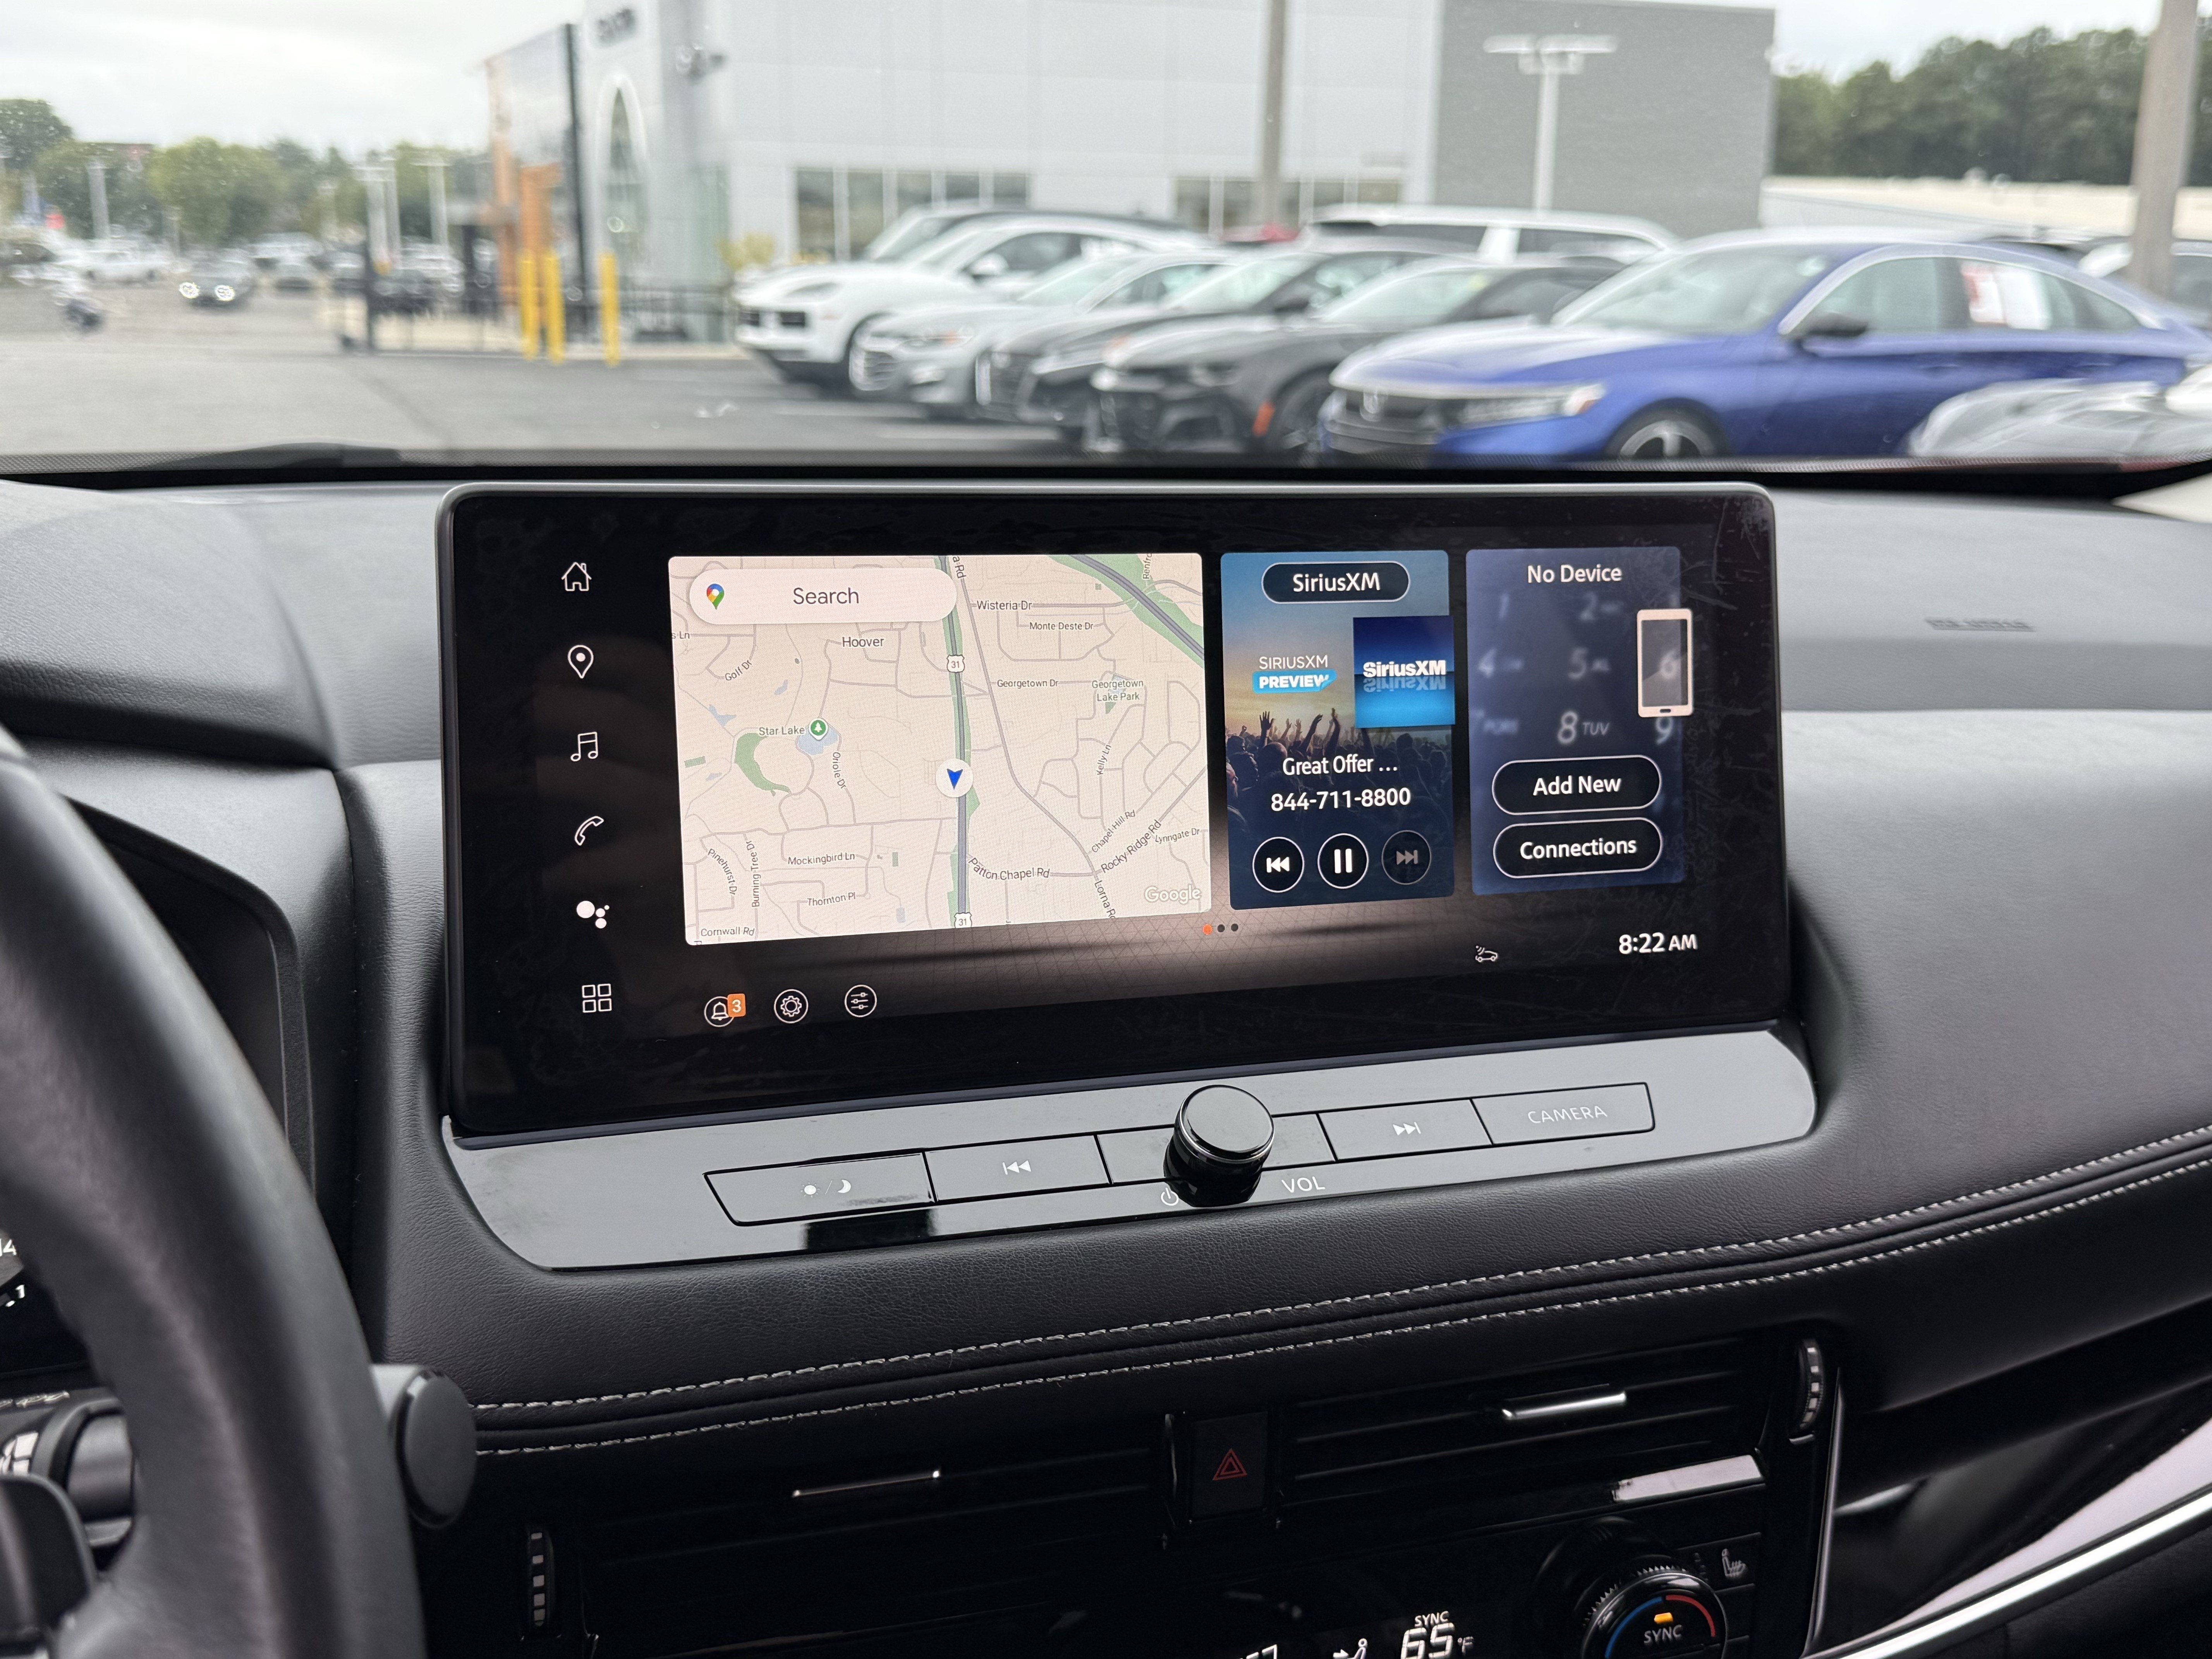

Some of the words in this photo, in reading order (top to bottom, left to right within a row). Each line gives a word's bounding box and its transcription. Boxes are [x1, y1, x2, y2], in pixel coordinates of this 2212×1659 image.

[955, 565, 967, 579] Rd
[1528, 565, 1555, 583] No
[1560, 563, 1623, 582] Device
[1293, 572, 1381, 592] SiriusXM
[793, 587, 859, 605] Search
[976, 600, 1018, 610] Wisteria
[1021, 600, 1032, 610] Dr
[679, 630, 690, 639] Ln
[1029, 622, 1056, 630] Monte
[1058, 622, 1083, 630] Deste
[1084, 622, 1094, 630] Dr
[842, 636, 884, 648] Hoover
[724, 666, 744, 682] Golf
[741, 659, 752, 672] Dr
[951, 661, 960, 669] 31
[1259, 655, 1328, 670] SIRIUSXM
[1363, 659, 1446, 678] SiriusXM
[997, 679, 1048, 688] Georgetown
[1049, 679, 1059, 687] Dr
[1092, 680, 1144, 689] Georgetown
[1259, 675, 1329, 689] PREVIEW
[1097, 693, 1118, 702] Lake
[1120, 692, 1140, 701] Park
[759, 726, 779, 735] Star
[781, 725, 805, 735] Lake
[1557, 710, 1579, 745] 8
[1097, 755, 1107, 775] Kelly
[1104, 744, 1111, 755] Ln
[1283, 757, 1329, 775] Great
[1333, 754, 1374, 774] Offer
[832, 752, 842, 778] Oriole
[837, 778, 847, 789] Dr
[1533, 775, 1573, 796] Add
[1578, 775, 1622, 794] New
[1271, 787, 1412, 812] 844-711-8800
[1091, 828, 1113, 854] Chapel
[1112, 816, 1125, 831] Hill
[1125, 809, 1135, 819] Rd
[1154, 830, 1190, 844] Lynngate
[1191, 828, 1200, 836] Dr
[745, 840, 755, 851] Dr
[1101, 851, 1128, 873] Rocky
[1127, 832, 1152, 855] Ridge
[1148, 819, 1161, 833] Rd
[1520, 838, 1637, 860] Connections
[750, 851, 759, 872] Tree
[788, 853, 843, 866] Mockingbird
[845, 852, 855, 861] Ln
[708, 848, 735, 884] Pinehurst
[729, 886, 737, 895] Dr
[968, 857, 998, 880] Patton
[1000, 867, 1034, 881] Chapel
[1037, 867, 1050, 878] Rd
[752, 874, 761, 907] Burning
[807, 893, 847, 907] Thornton
[847, 892, 856, 900] Pl
[1094, 880, 1110, 908] Lorna
[1145, 884, 1201, 903] Google
[958, 918, 967, 926] 31
[701, 927, 740, 936] Cornwall
[743, 927, 755, 936] Rd
[1618, 932, 1666, 954] 8:22
[1668, 934, 1698, 951] AM
[732, 999, 742, 1013] 3
[1527, 1106, 1608, 1125] CAMERA
[1281, 1176, 1326, 1194] VOL
[1414, 1610, 1450, 1628] SYNC
[1643, 1624, 1683, 1646] SYNC
